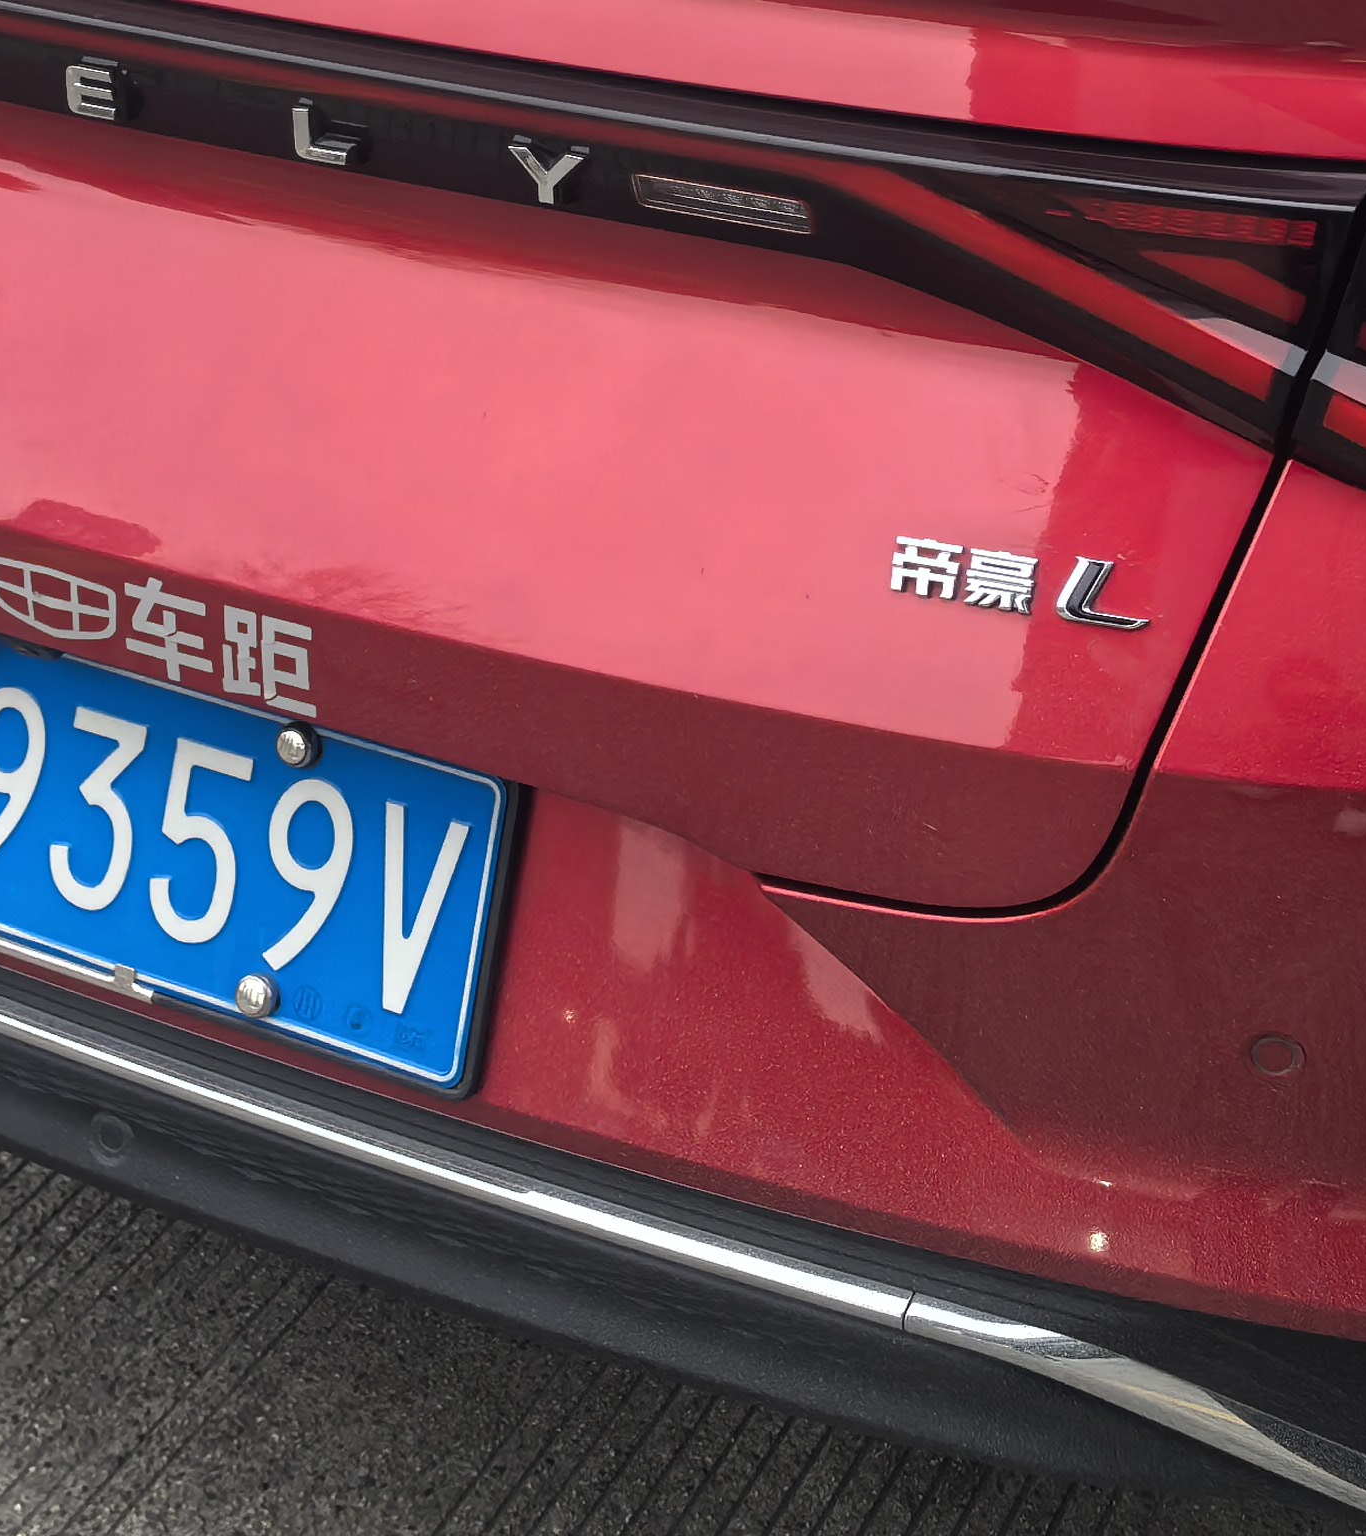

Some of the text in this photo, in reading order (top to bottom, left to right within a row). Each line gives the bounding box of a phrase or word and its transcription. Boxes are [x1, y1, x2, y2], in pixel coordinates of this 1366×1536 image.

[890, 535, 1151, 631] 帝豪 L
[124, 576, 318, 719] 车距
